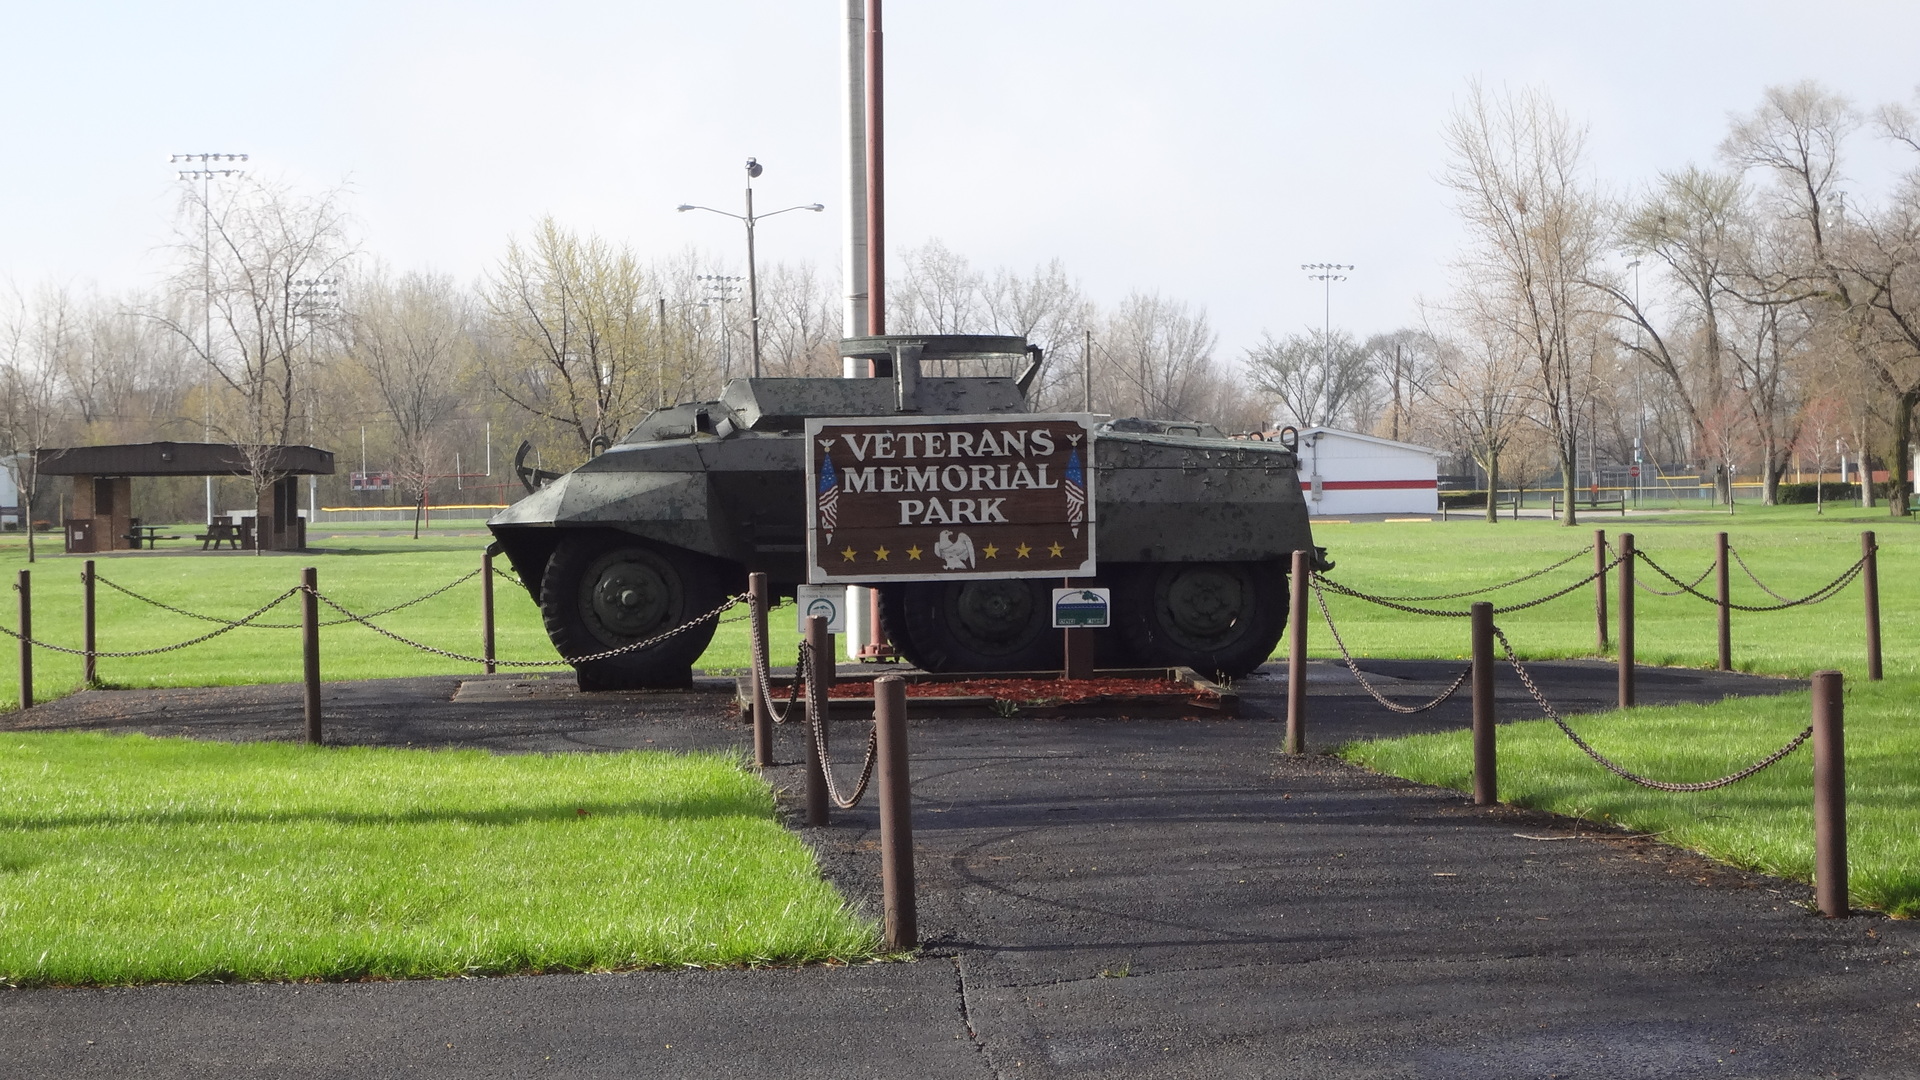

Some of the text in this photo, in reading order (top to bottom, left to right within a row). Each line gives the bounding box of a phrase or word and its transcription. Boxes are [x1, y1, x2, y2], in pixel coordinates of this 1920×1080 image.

[841, 429, 1055, 461] VETERANS
[842, 462, 1059, 493] MEMORIAL
[898, 496, 1009, 525] PARK
